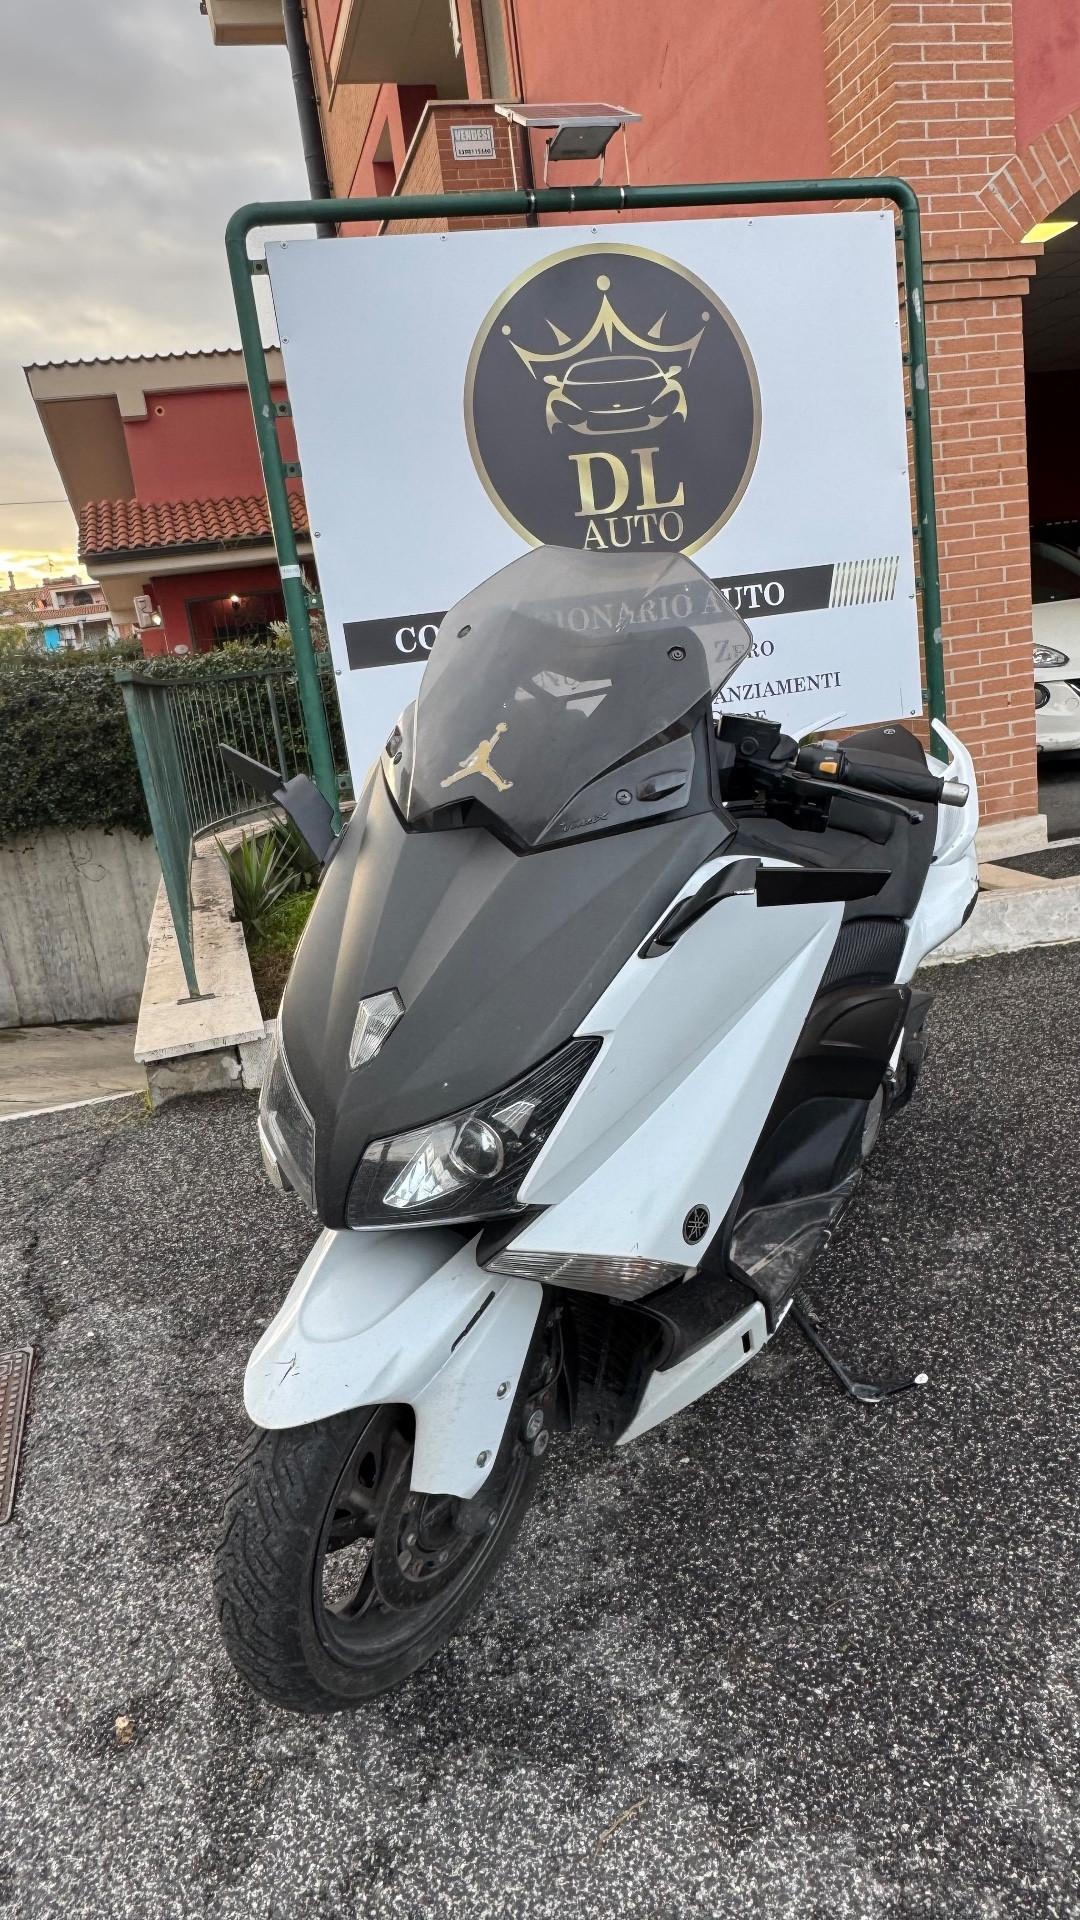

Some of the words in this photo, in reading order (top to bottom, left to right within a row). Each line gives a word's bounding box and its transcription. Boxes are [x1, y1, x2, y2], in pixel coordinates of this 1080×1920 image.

[454, 128, 491, 141] VENDESI
[568, 447, 685, 516] DL
[582, 511, 684, 550] AUTO
[713, 671, 842, 705] ANZIAMENTI
